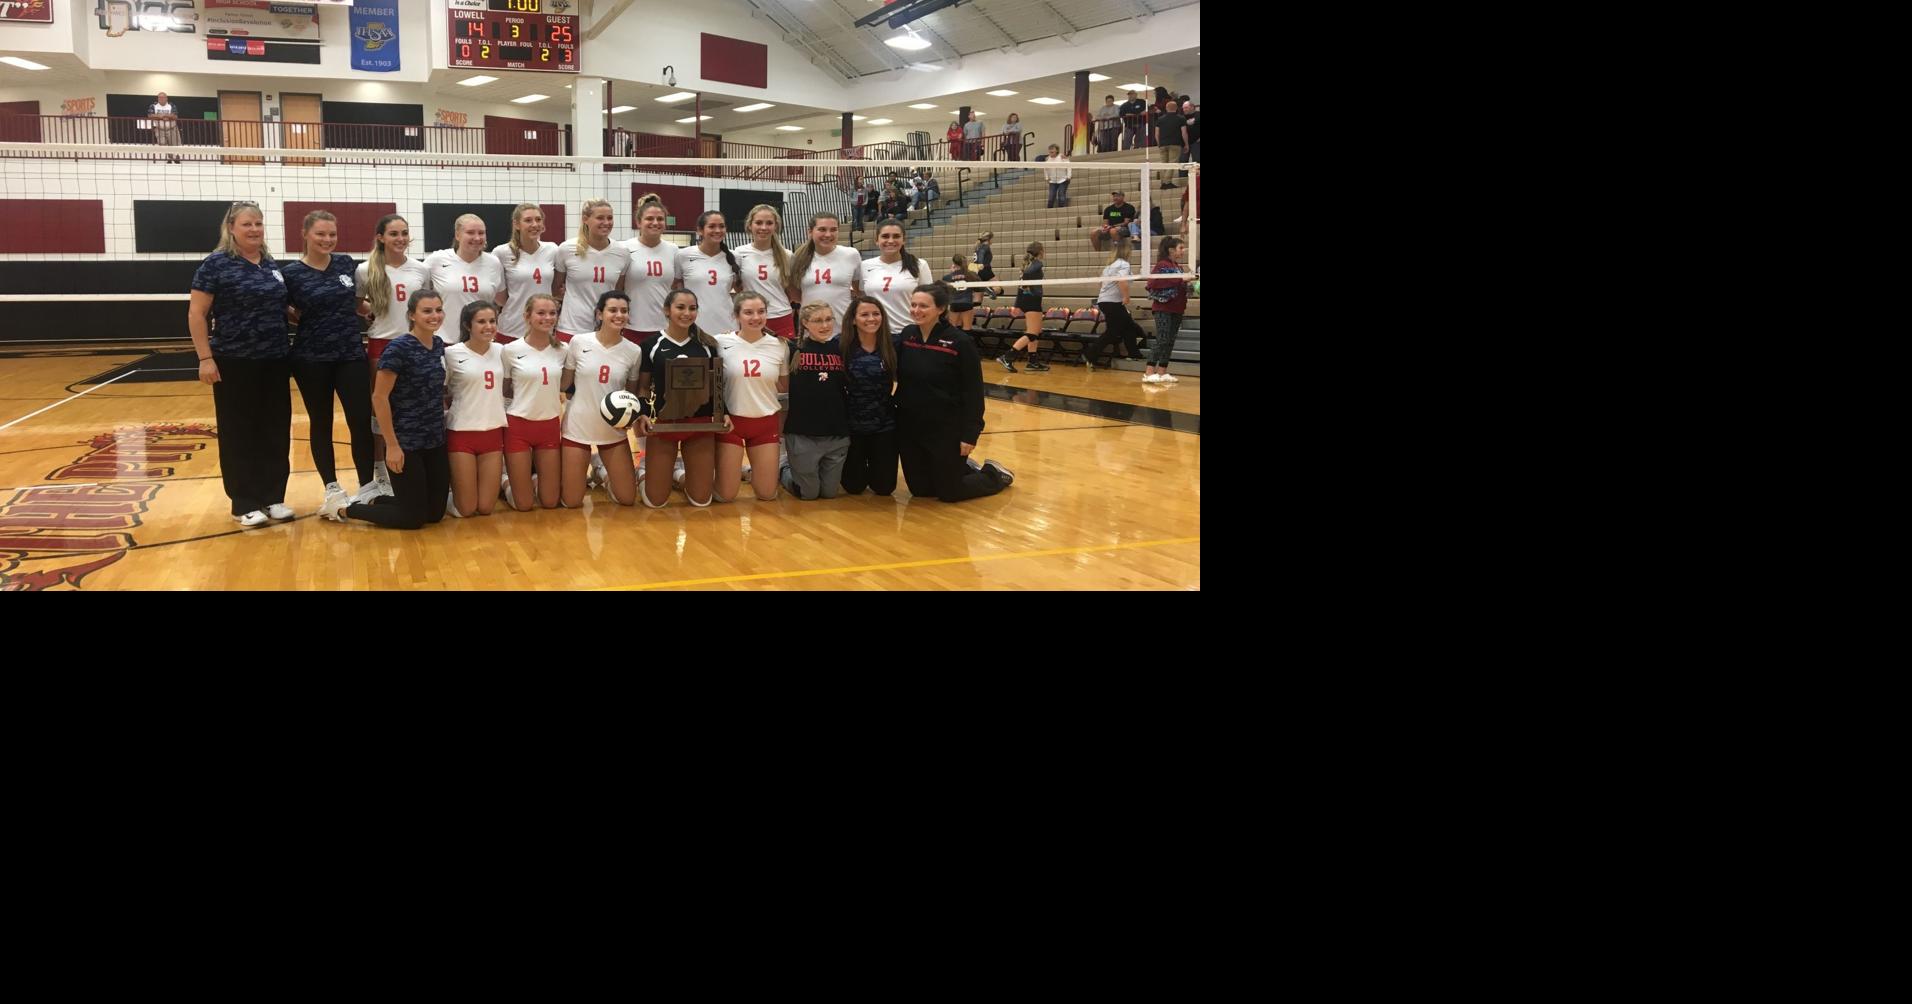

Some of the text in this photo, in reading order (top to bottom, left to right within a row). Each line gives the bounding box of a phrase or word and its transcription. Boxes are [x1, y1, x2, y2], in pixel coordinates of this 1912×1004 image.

[273, 6, 313, 15] TOGETHER
[353, 7, 395, 16] MEMBER
[454, 10, 485, 19] LOWELL
[546, 16, 571, 24] GUEST
[468, 22, 483, 37] 14
[512, 25, 519, 38] 3
[551, 25, 572, 42] 25
[462, 45, 470, 57] 0
[481, 46, 490, 59] 2
[541, 48, 549, 61] 2
[564, 50, 572, 63] 3
[441, 110, 468, 124] SPORTS
[532, 267, 542, 285] 4
[593, 265, 606, 284] 11
[646, 260, 663, 277] 10
[758, 264, 769, 281] 5
[814, 268, 832, 285] 14
[462, 275, 479, 293] 13
[708, 269, 718, 286] 3
[882, 276, 892, 293] 7
[395, 283, 406, 302] 6
[542, 367, 549, 385] 1
[598, 364, 610, 384] 8
[742, 359, 762, 377] 12
[484, 370, 495, 390] 9
